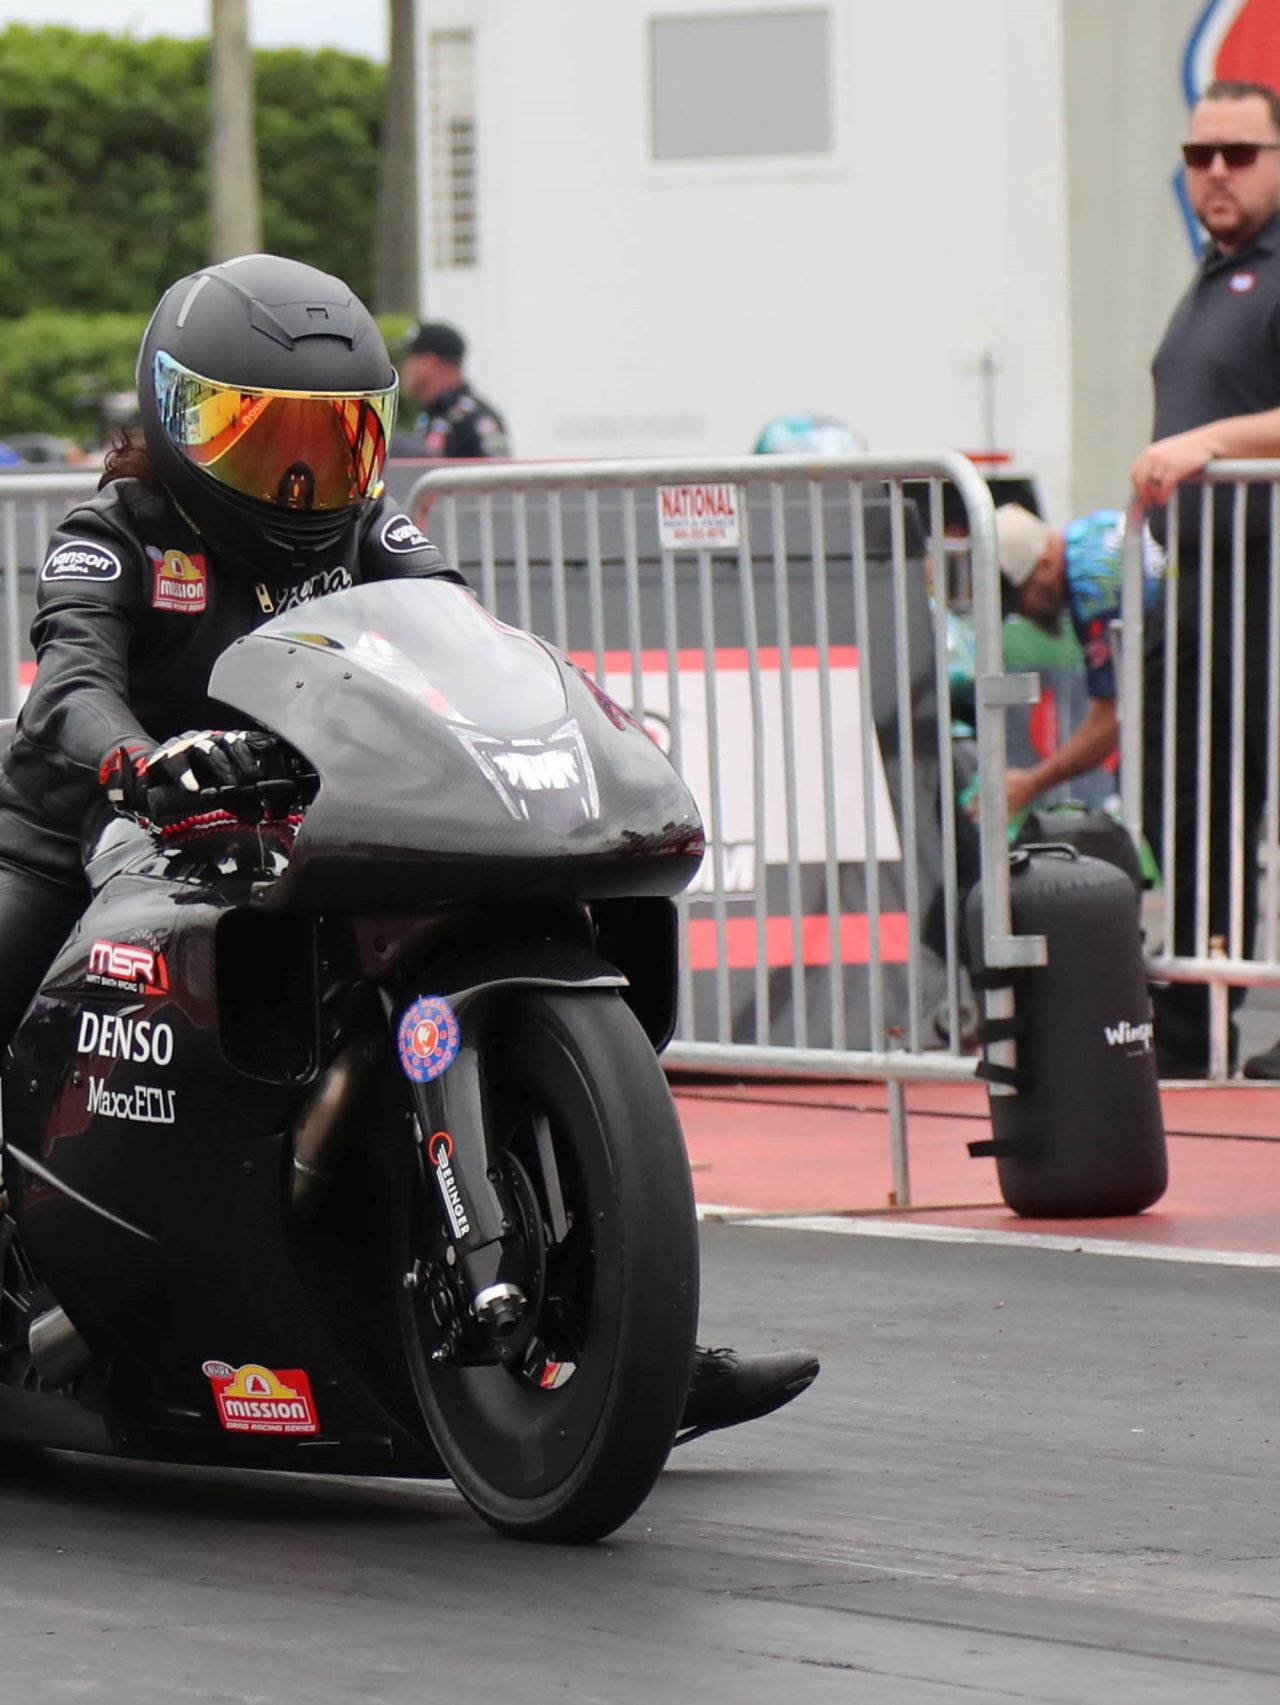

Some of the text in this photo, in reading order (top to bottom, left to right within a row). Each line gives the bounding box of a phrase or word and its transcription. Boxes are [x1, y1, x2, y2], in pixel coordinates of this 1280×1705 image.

[662, 487, 735, 517] NATIONAL
[89, 943, 154, 985] MSR
[77, 1011, 174, 1065] DENSO
[87, 1076, 176, 1123] MaxxECU
[437, 1143, 470, 1237] BERINGER
